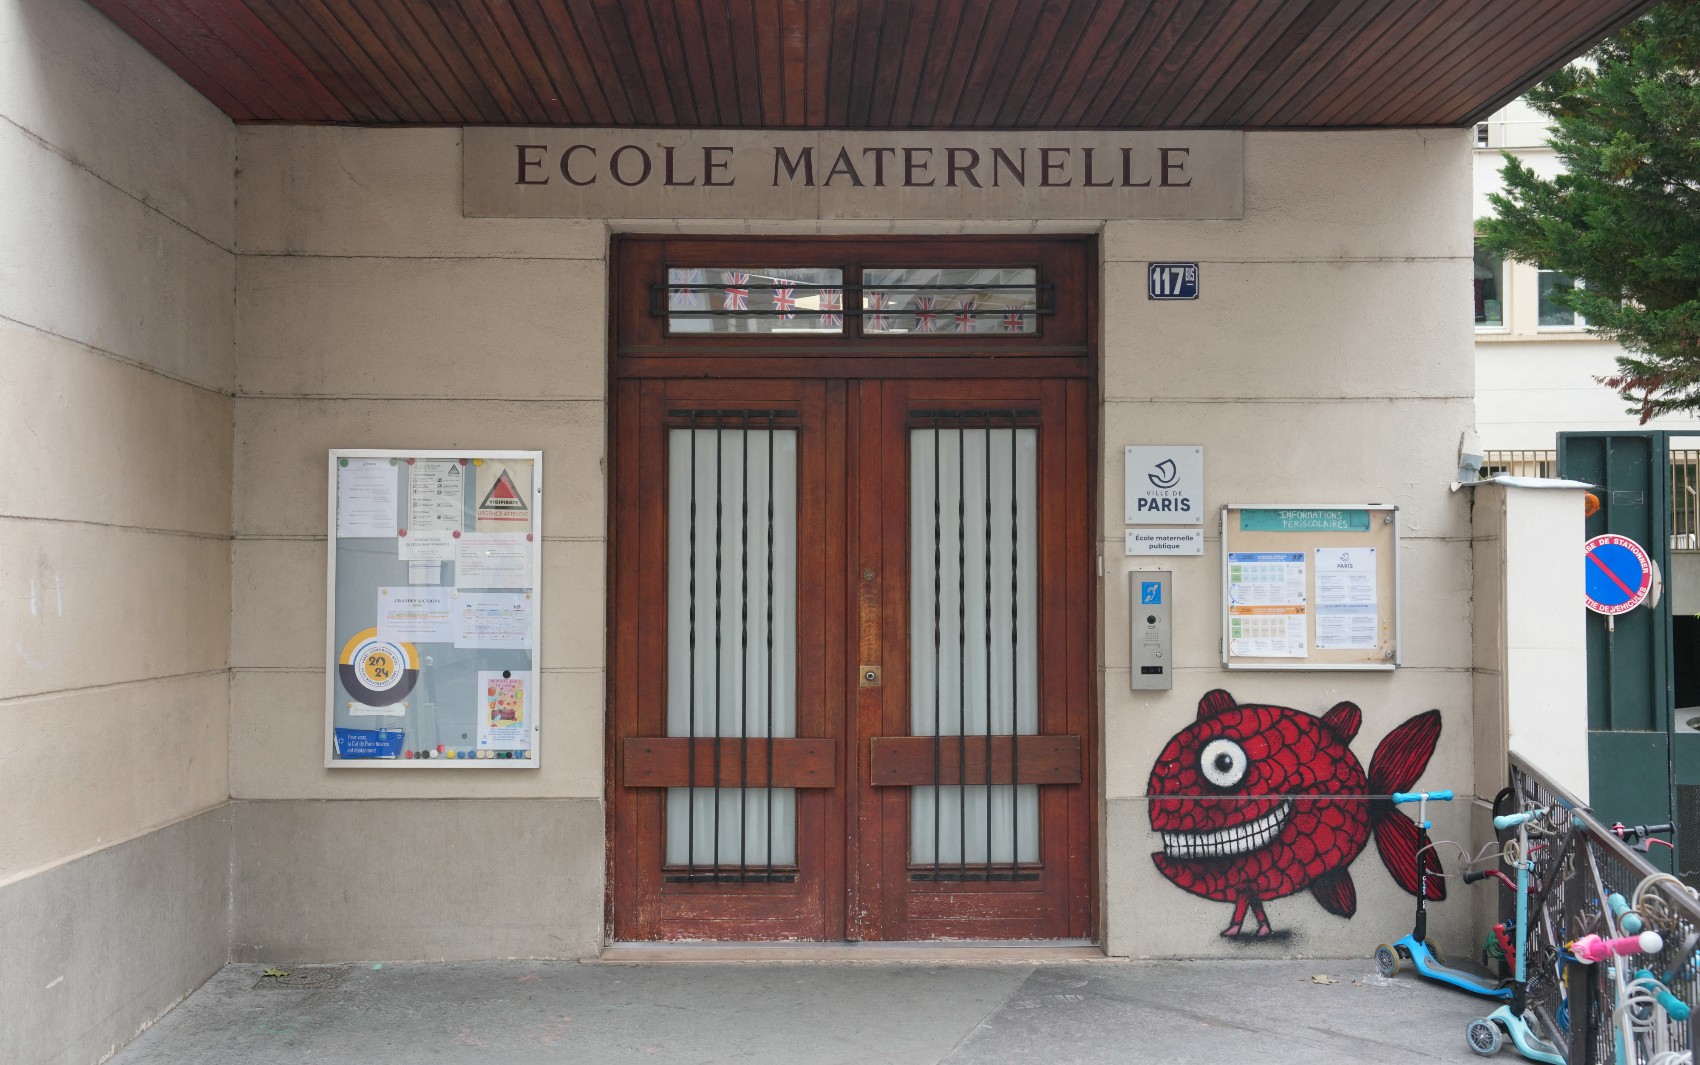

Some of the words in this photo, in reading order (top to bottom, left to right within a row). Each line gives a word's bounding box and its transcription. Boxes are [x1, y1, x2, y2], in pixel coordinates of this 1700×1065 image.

[514, 144, 736, 187] ECOLE
[772, 145, 1192, 188] MATERNELLE
[1153, 267, 1184, 294] 117
[1137, 497, 1191, 512] PARIS
[1279, 510, 1343, 520] INFORMATIONS
[1135, 533, 1155, 541] École
[1149, 542, 1181, 550] publique
[1613, 538, 1649, 574] STATIONNER
[369, 656, 386, 666] 20
[375, 667, 389, 678] 24
